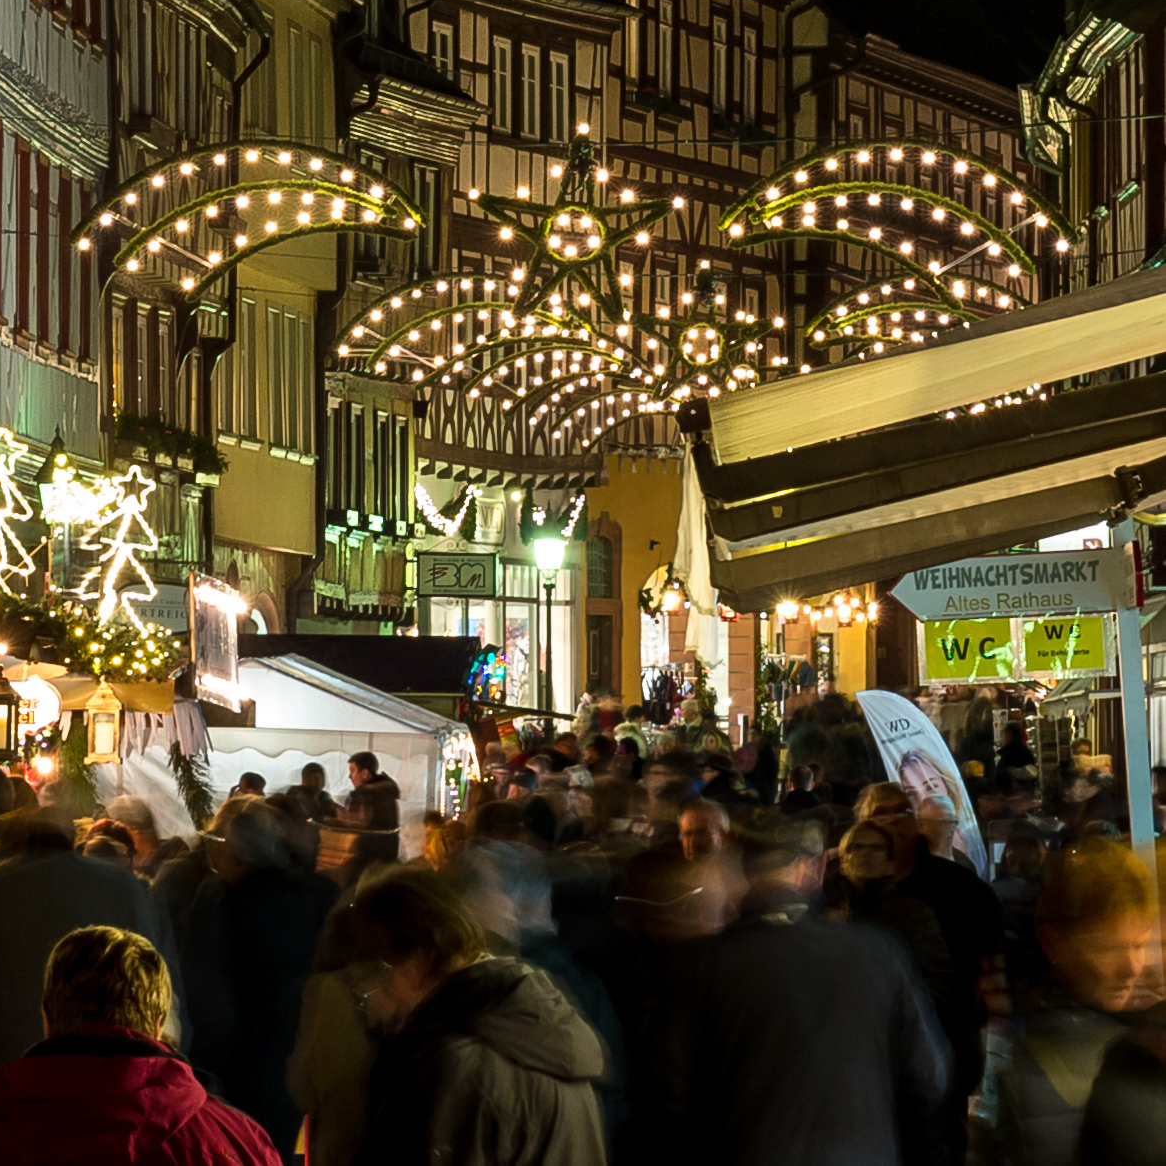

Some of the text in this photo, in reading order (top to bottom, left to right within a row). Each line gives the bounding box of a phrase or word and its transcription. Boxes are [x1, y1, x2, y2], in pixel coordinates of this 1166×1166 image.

[913, 559, 1100, 591] WEIHNACHTSMARKT
[945, 592, 1074, 613] Altes Rathaus
